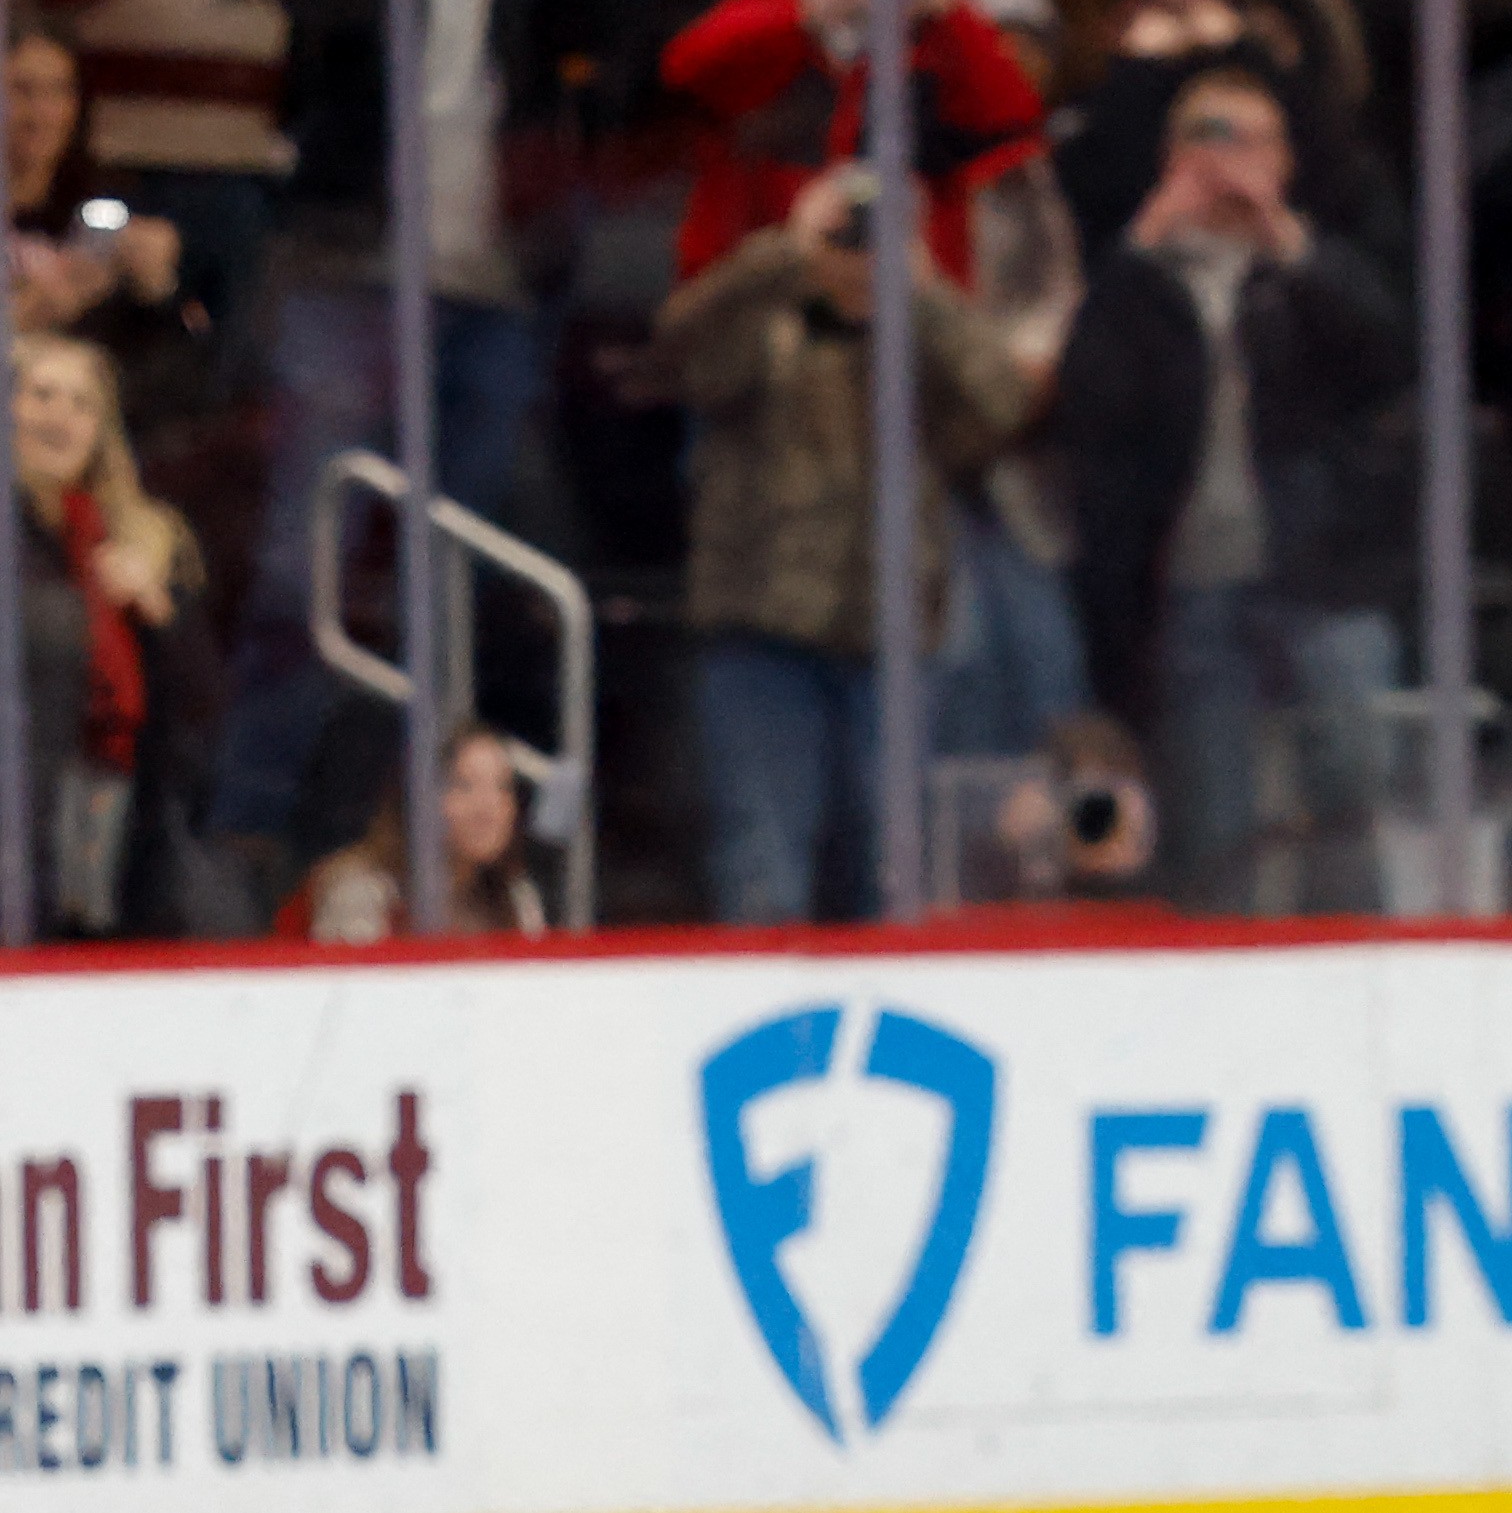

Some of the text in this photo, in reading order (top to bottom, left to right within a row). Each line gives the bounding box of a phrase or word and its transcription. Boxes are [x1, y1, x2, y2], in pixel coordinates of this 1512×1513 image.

[0, 1088, 432, 1315] n First
[211, 1348, 440, 1468] UNION
